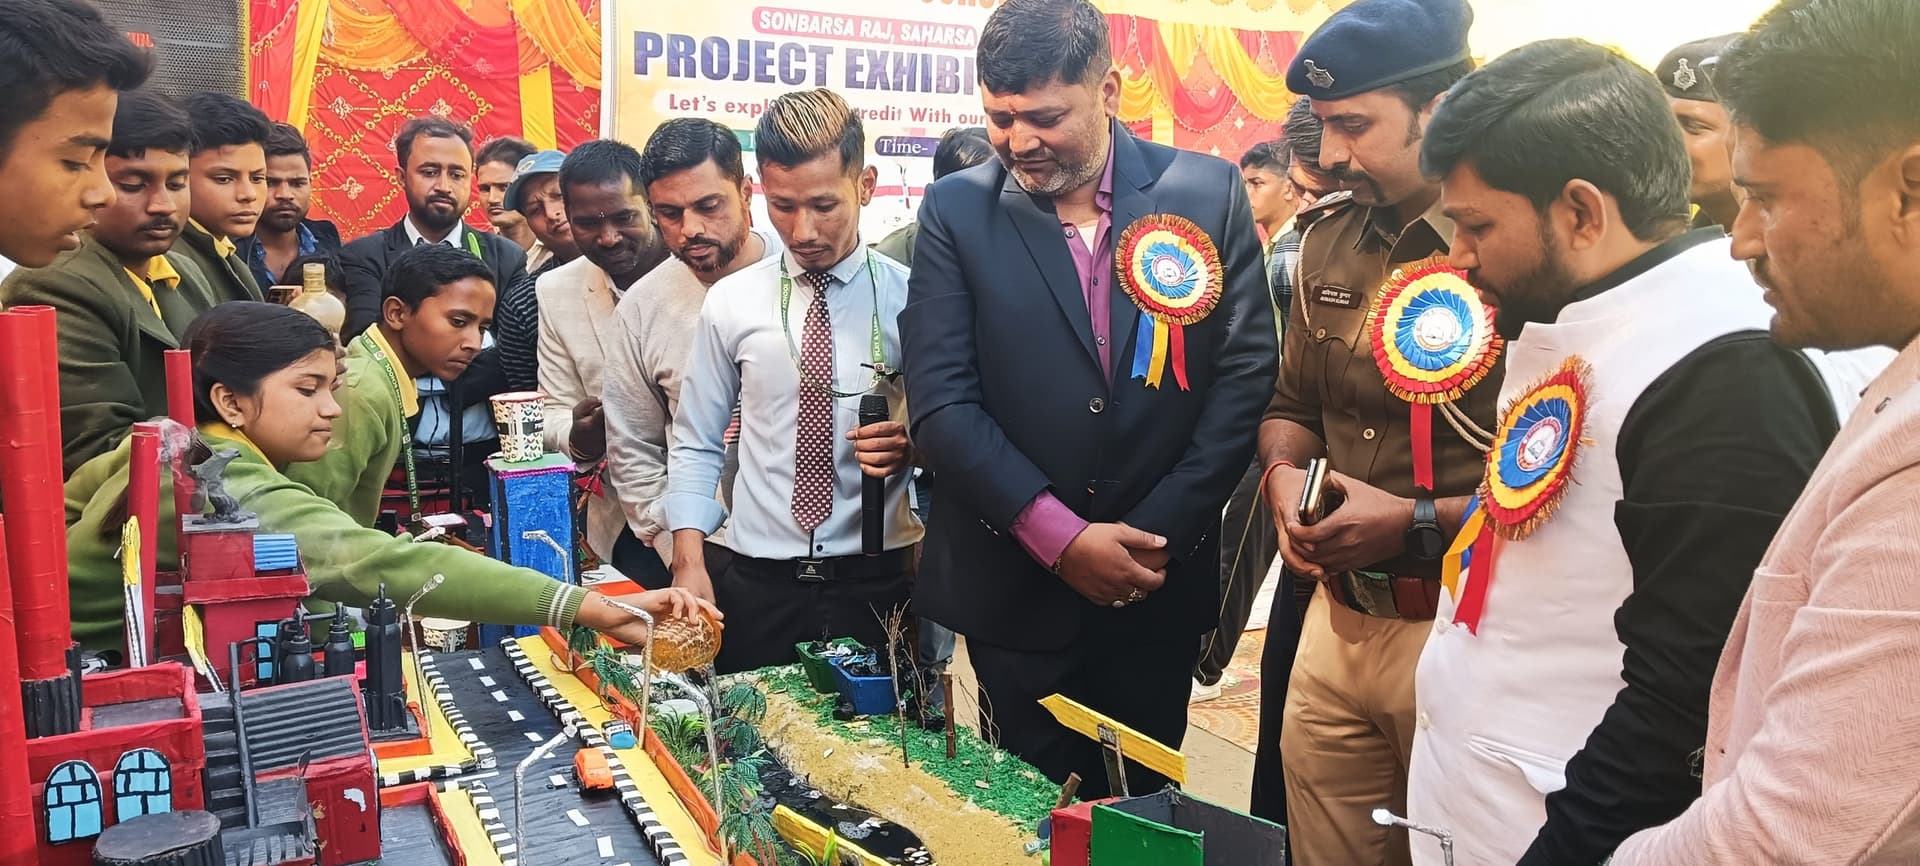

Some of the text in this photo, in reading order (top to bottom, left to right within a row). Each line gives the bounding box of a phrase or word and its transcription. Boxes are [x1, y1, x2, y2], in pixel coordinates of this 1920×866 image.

[759, 10, 975, 46] SONBARSA RAJ, SAHARSA
[633, 31, 975, 96] PROJECT EXHIBI
[669, 94, 717, 112] Let's
[909, 107, 951, 123] With
[959, 113, 987, 124] our
[880, 138, 928, 154] Time-
